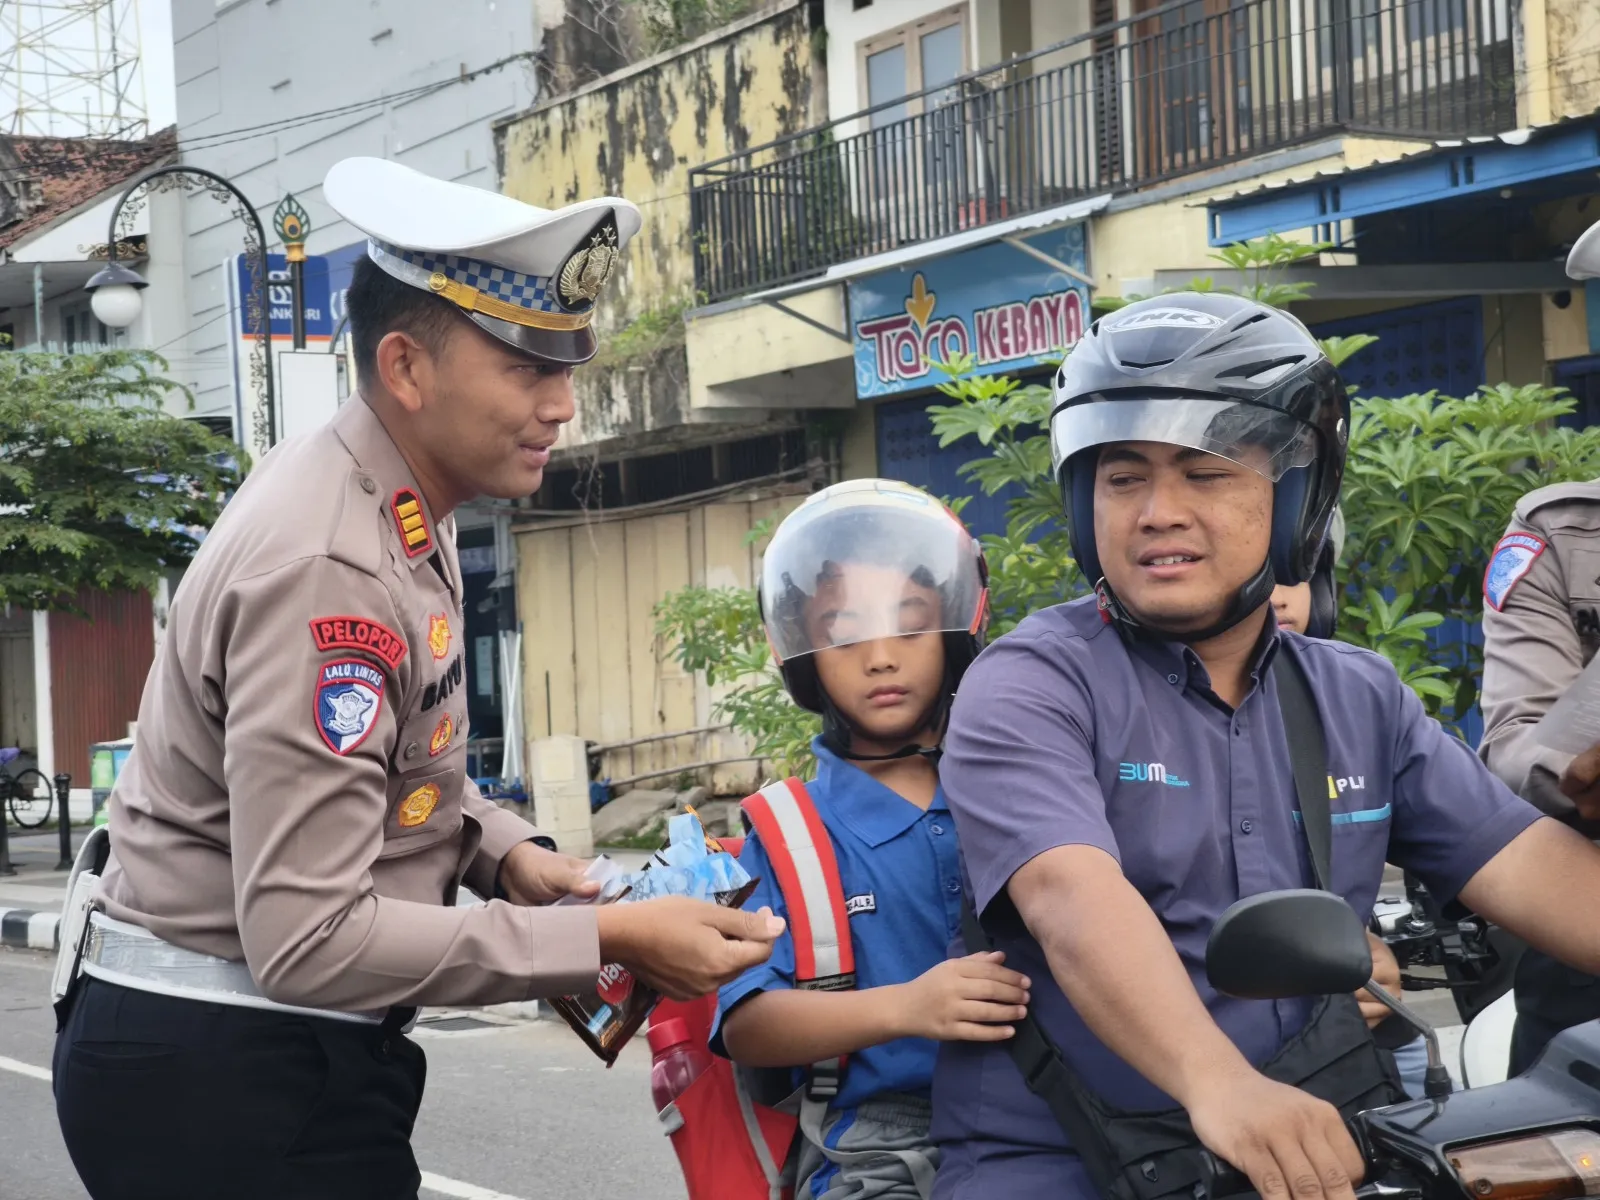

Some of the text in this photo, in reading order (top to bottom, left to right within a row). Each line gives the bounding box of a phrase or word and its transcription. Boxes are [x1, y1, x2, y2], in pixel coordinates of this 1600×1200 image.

[973, 287, 1083, 366] KEBAYA
[319, 620, 401, 661] PELOPOR
[354, 664, 383, 687] LINTAS
